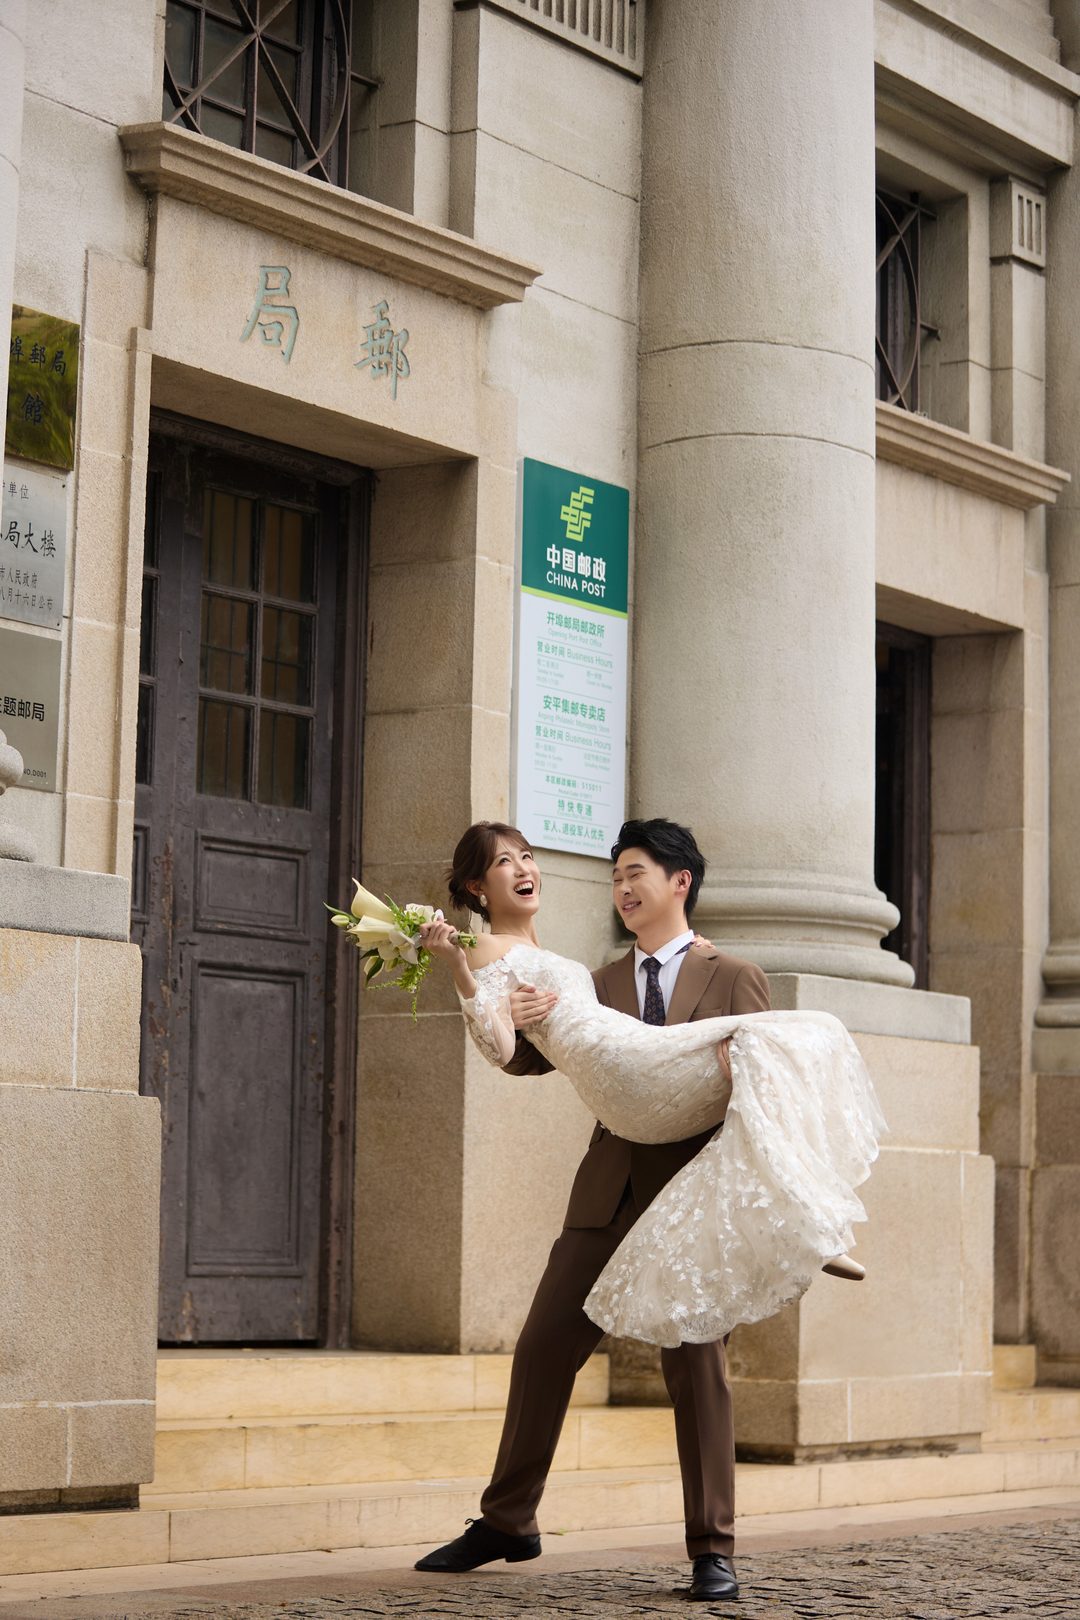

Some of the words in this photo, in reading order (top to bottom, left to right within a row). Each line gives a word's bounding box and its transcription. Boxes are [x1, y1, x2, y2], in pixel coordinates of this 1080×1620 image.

[2, 480, 29, 500] 单位
[0, 520, 57, 558] 局大楼
[546, 543, 606, 583] 中国邮政
[546, 570, 579, 591] CHINA
[581, 580, 606, 598] POST
[546, 611, 605, 639] 开埠邮局邮政所
[537, 640, 565, 658] 营业时间
[566, 647, 594, 665] Business
[595, 656, 613, 670] Hours
[543, 694, 606, 723] 安平集邮专卖店
[535, 725, 564, 742] 营业时间
[565, 731, 593, 748] Business
[594, 738, 612, 752] Hours
